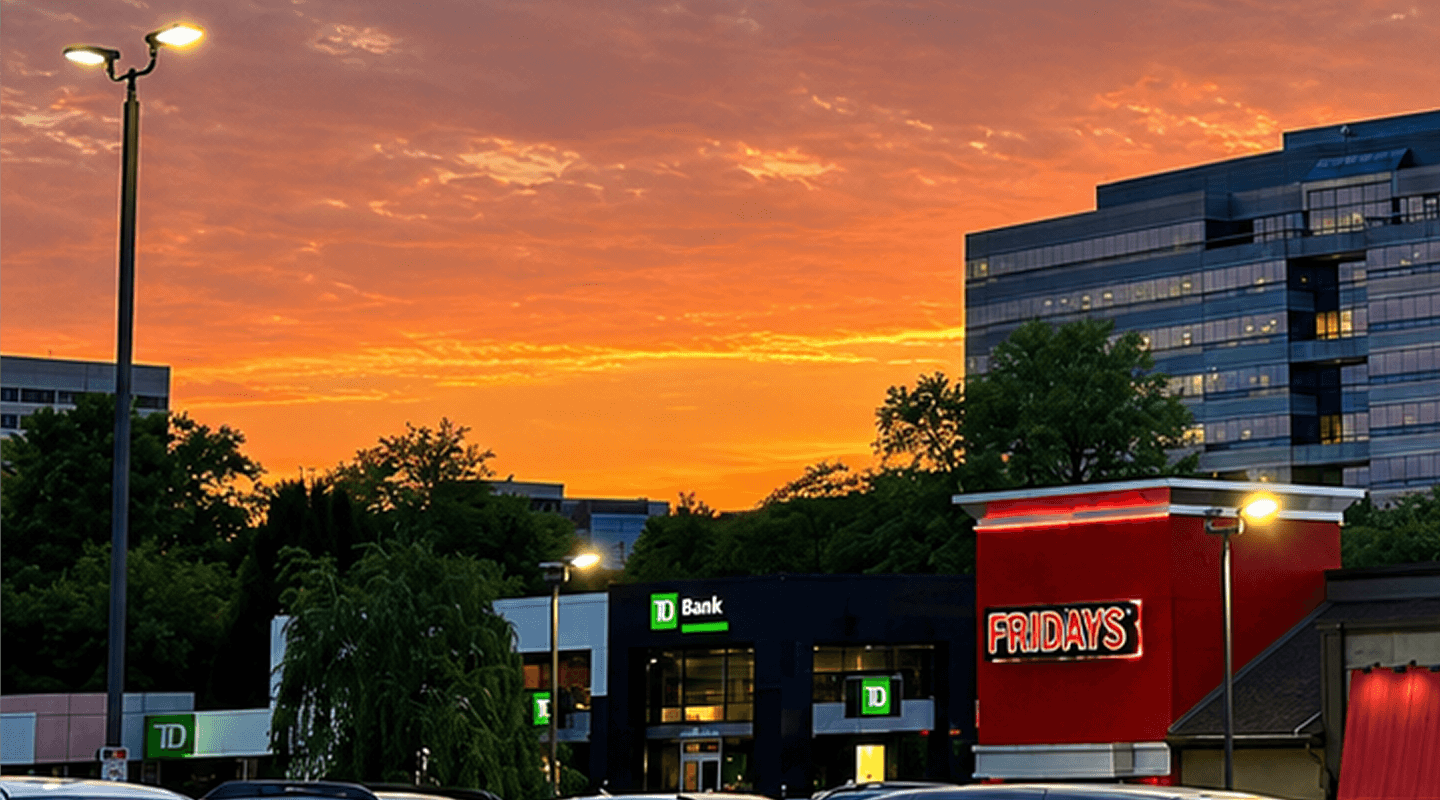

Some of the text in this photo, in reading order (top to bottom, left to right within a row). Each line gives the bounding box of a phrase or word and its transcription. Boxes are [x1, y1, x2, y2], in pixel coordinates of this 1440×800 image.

[653, 595, 723, 622] TD Bank
[988, 606, 1127, 654] FRIDAYS
[866, 686, 887, 707] TD
[153, 724, 187, 749] TD
